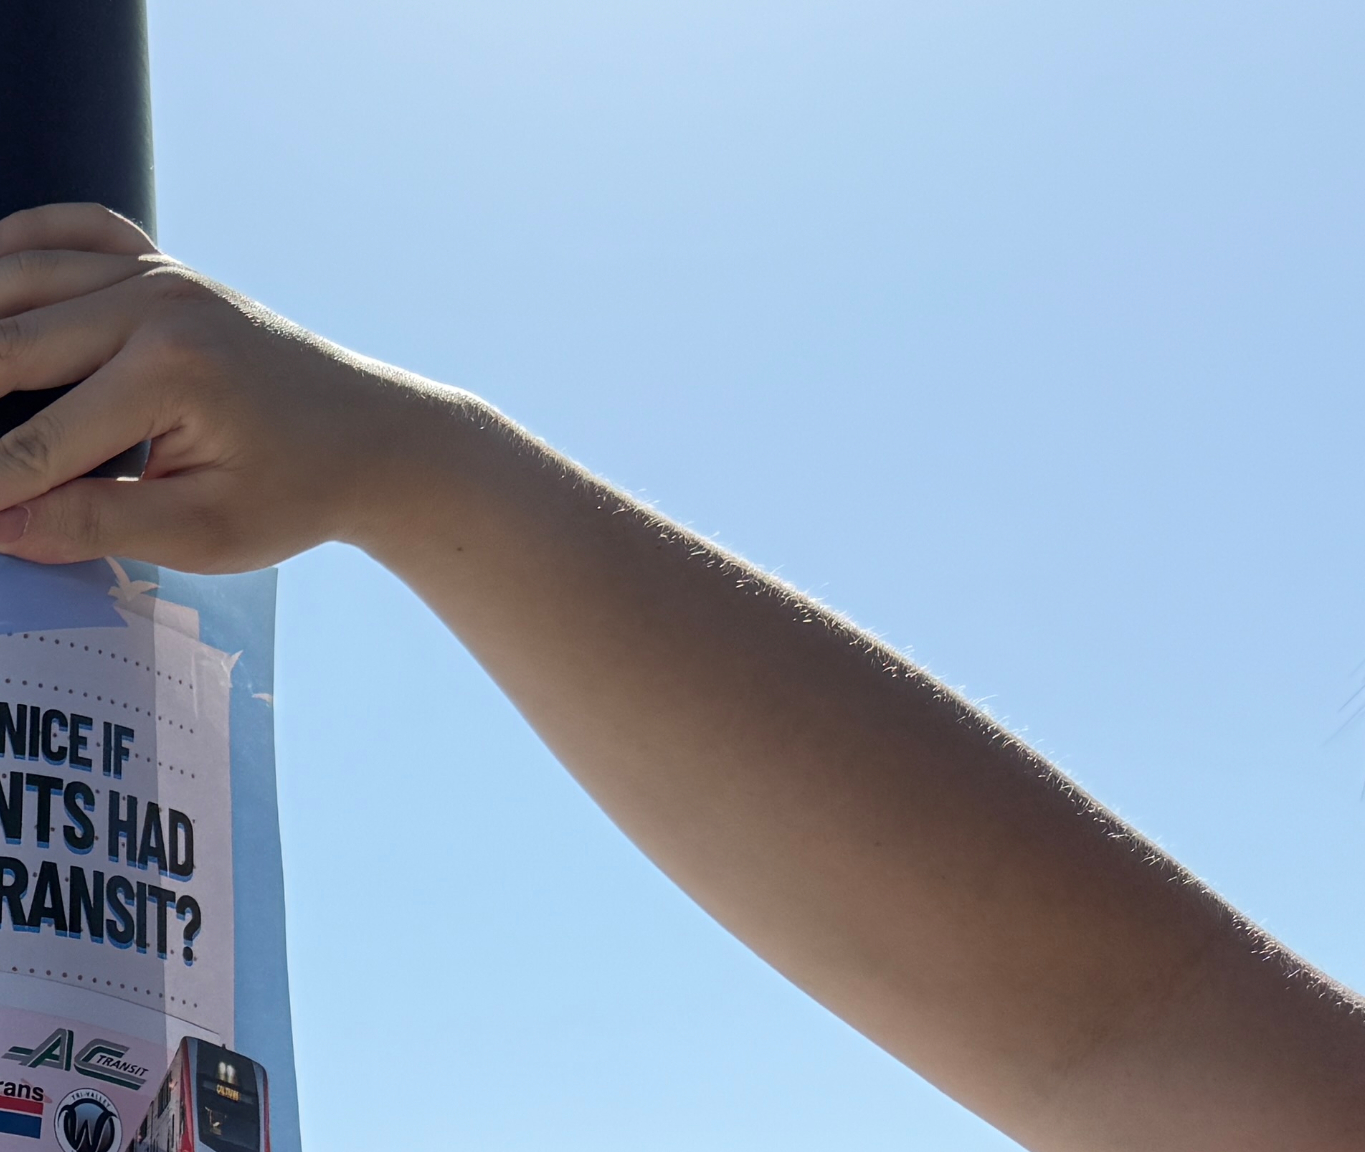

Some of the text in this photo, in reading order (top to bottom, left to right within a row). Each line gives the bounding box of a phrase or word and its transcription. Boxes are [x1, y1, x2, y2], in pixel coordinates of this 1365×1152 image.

[103, 721, 135, 777] IF
[108, 789, 195, 880] HAD
[95, 1054, 149, 1077] TRANSIT
